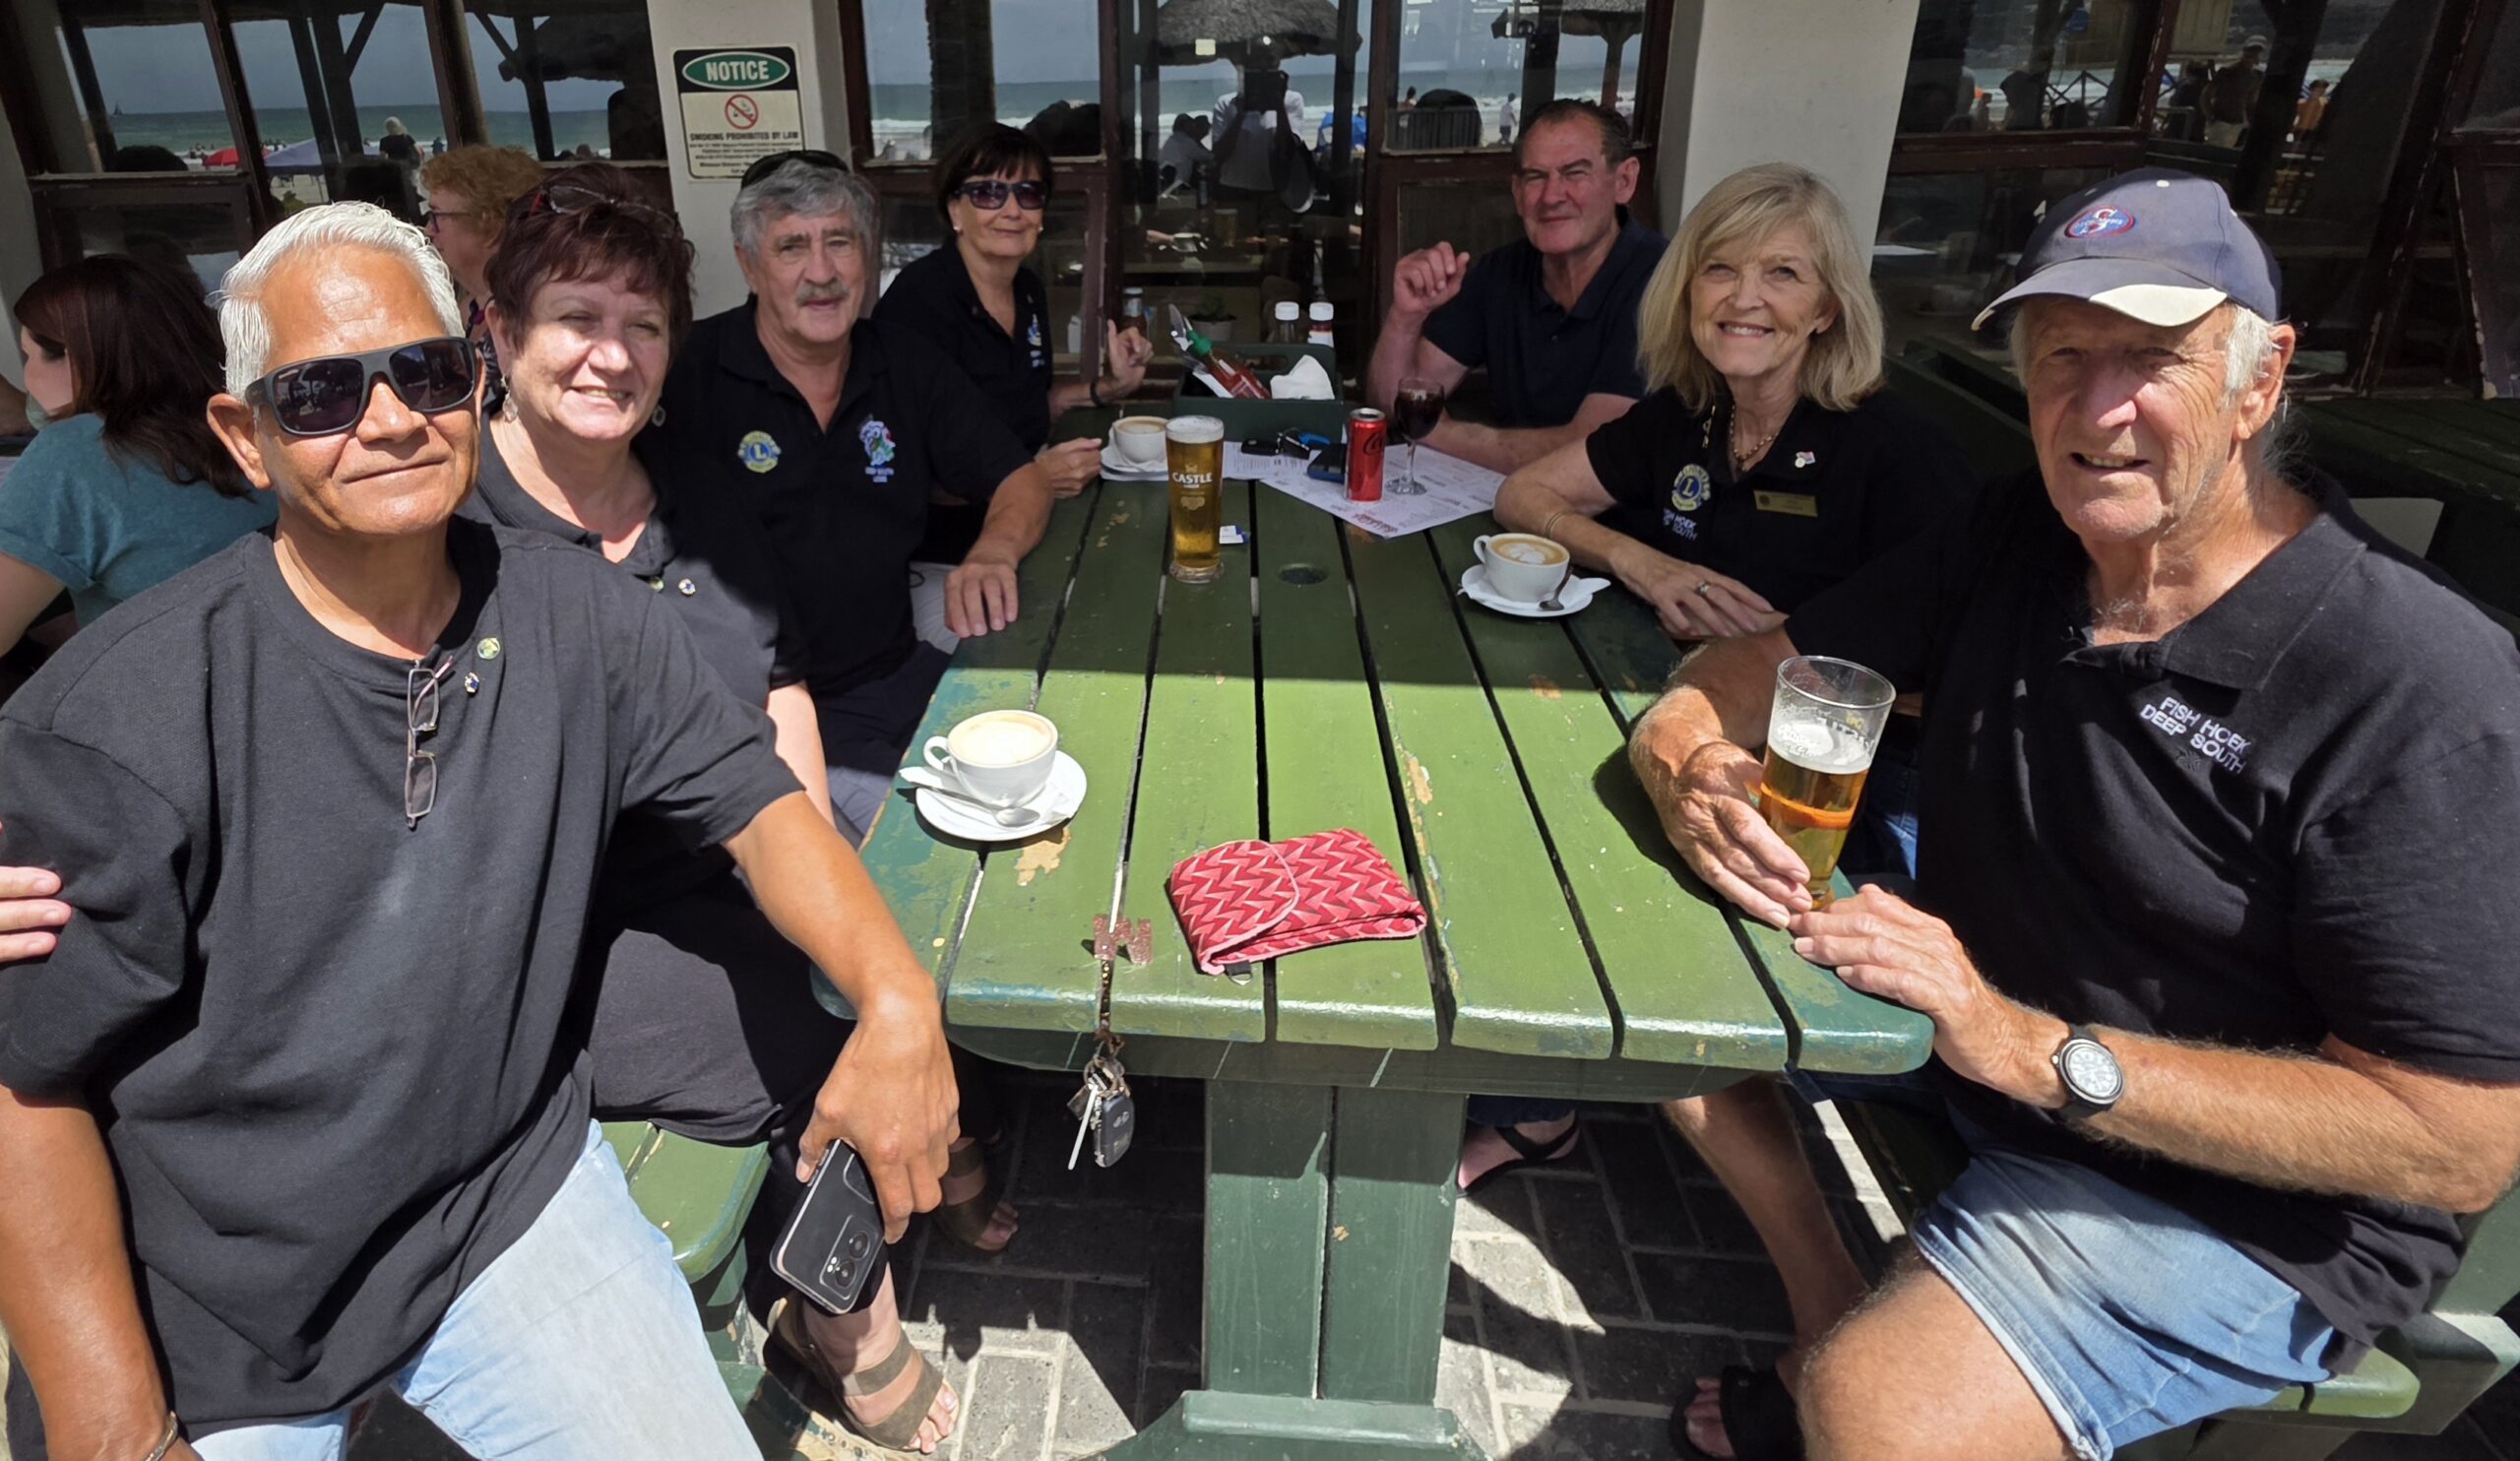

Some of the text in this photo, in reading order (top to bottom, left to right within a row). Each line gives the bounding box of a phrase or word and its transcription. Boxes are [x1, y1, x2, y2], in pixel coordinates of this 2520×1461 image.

[705, 60, 770, 81] NOTICE
[1172, 472, 1213, 484] CASTLE
[2140, 704, 2246, 774] DEEP SOUTH
[2159, 696, 2251, 754] FISH HOEK
